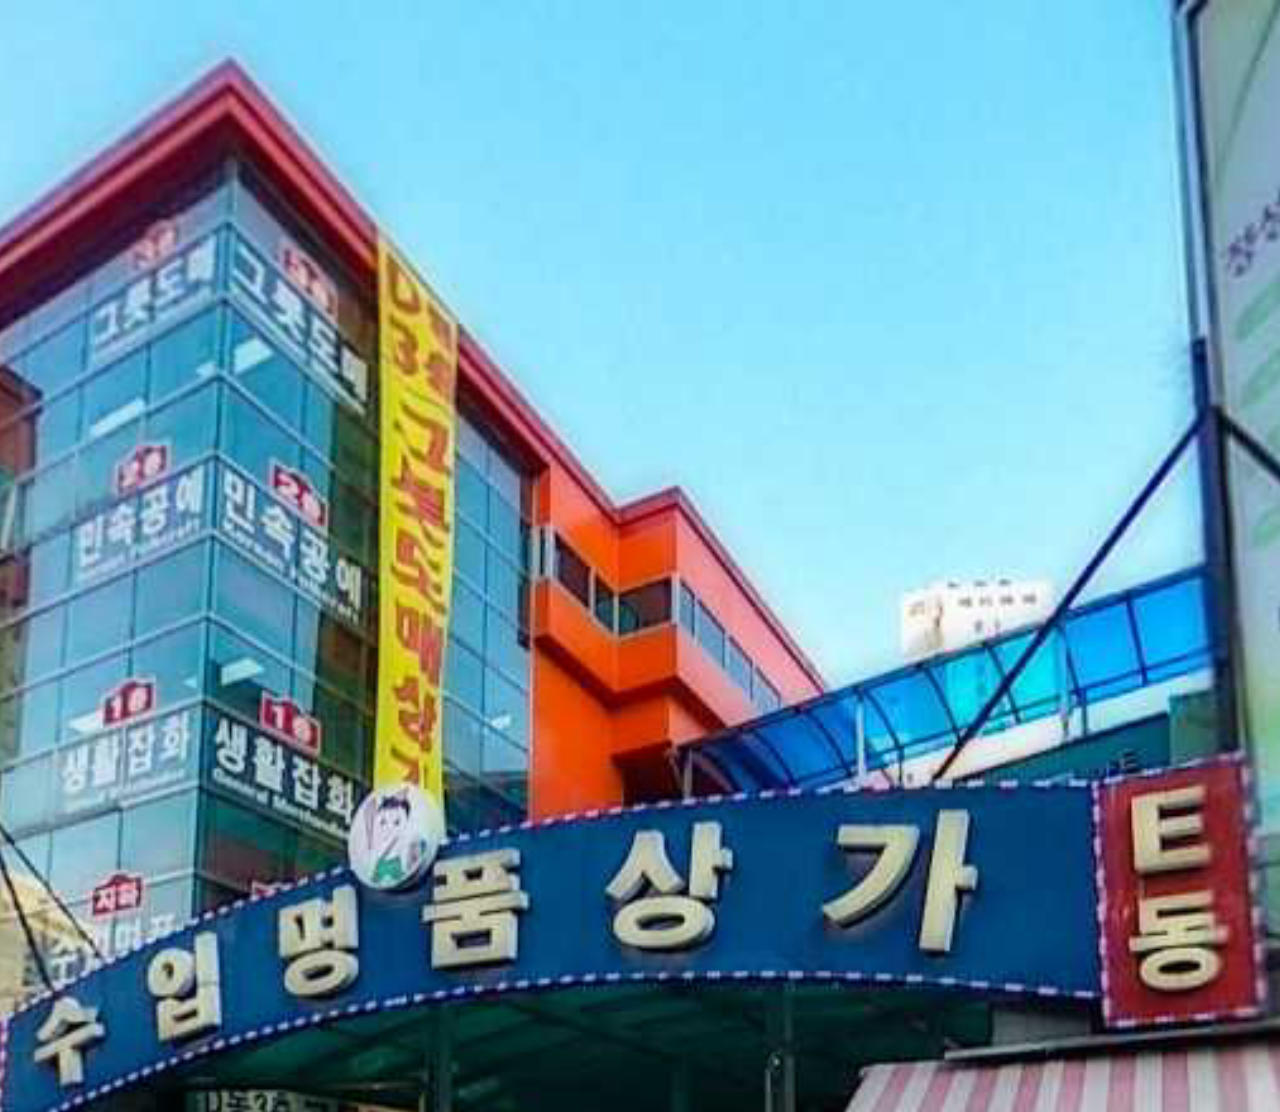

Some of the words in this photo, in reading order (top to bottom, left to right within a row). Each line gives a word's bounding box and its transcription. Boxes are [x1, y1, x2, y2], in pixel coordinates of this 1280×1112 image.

[222, 468, 362, 614] 민속공예
[61, 707, 189, 796] 생활잡화
[215, 716, 356, 827] 생활잡화
[33, 807, 978, 1087] 수입명품상가
